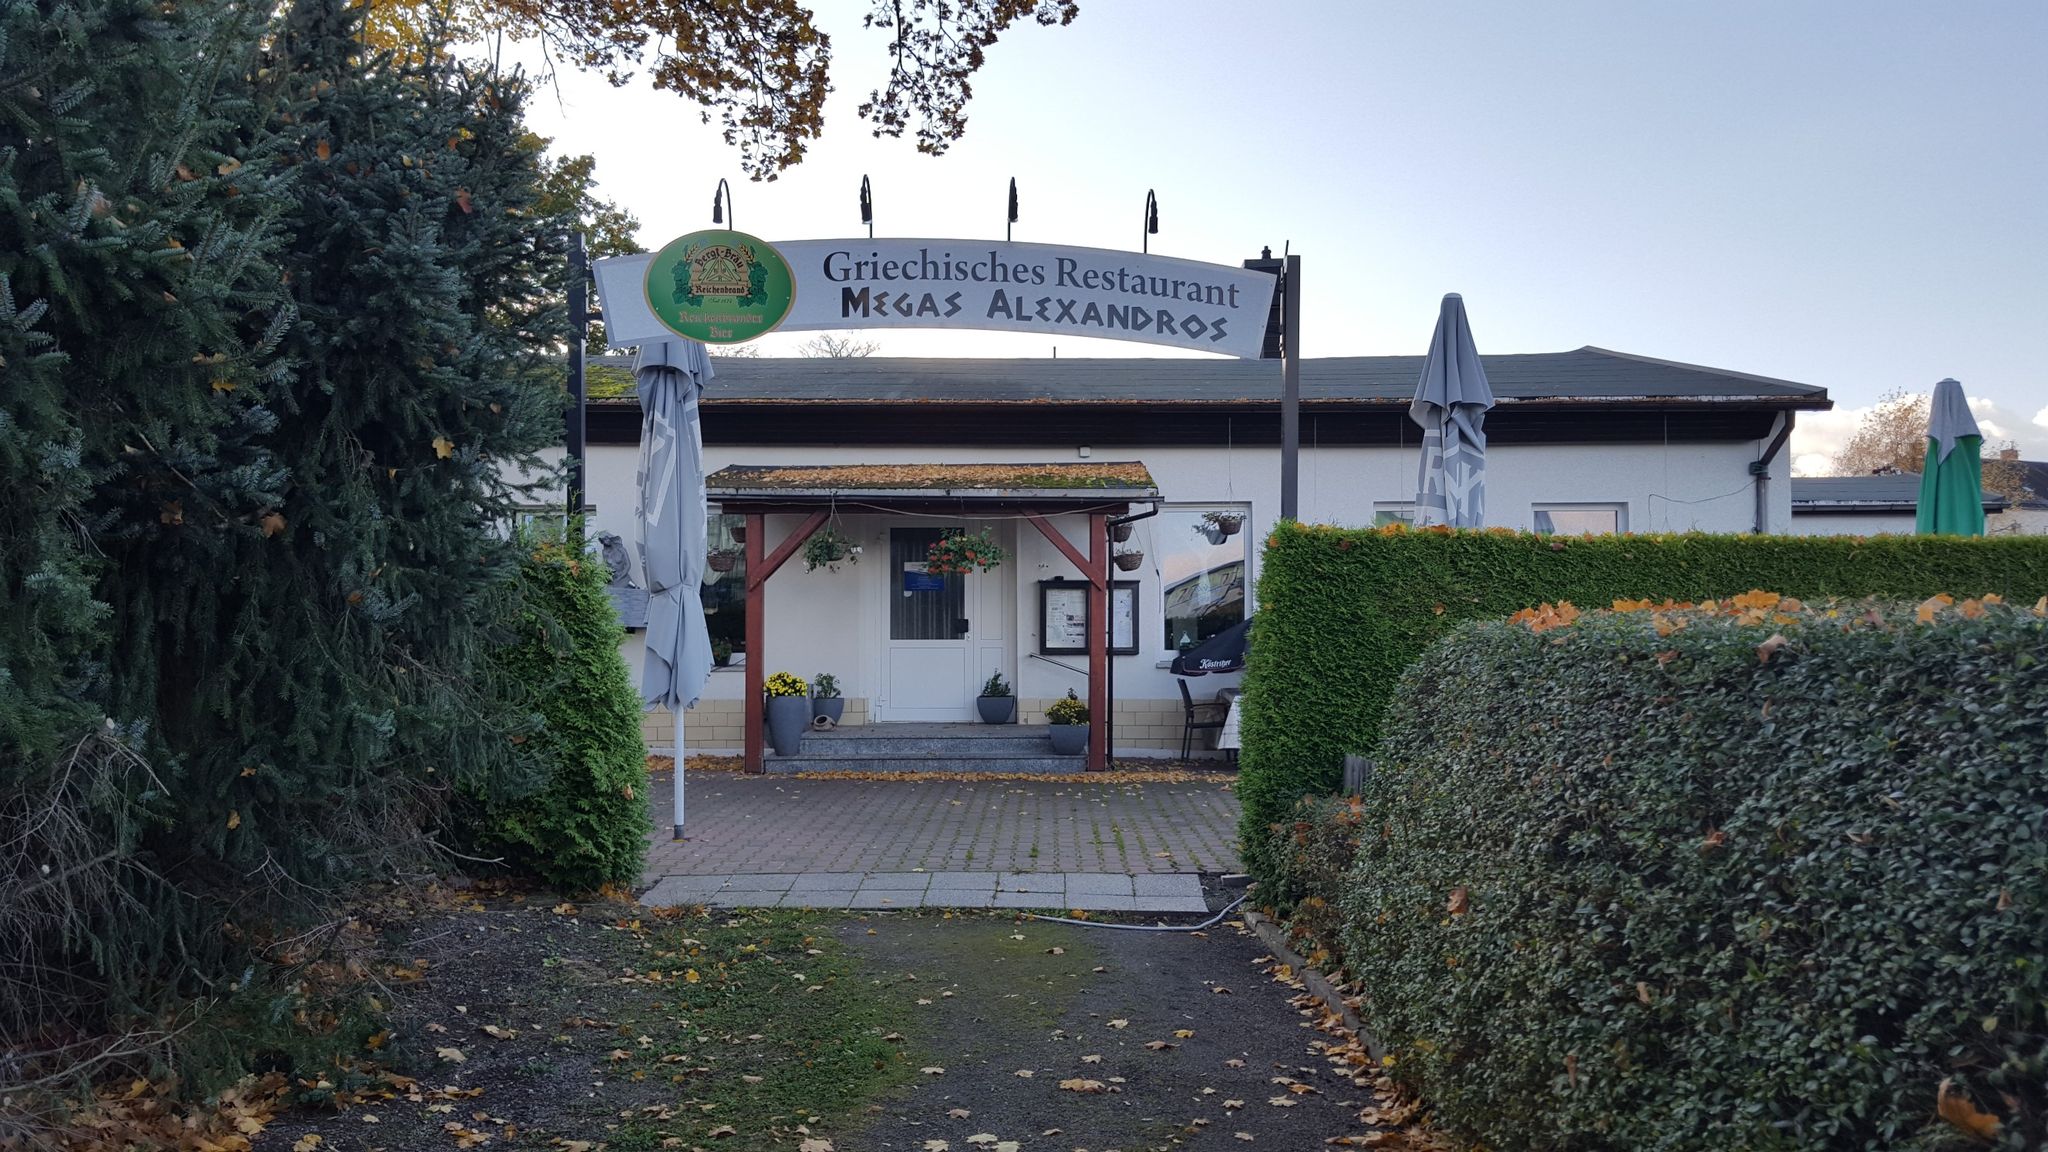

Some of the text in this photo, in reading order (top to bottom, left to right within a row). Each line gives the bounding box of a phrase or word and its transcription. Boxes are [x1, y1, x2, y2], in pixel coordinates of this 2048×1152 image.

[695, 285, 745, 294] Reichenbrand
[823, 248, 1240, 308] Griechisches Restaurant
[842, 286, 1228, 342] MEGAS ALEXANDROS
